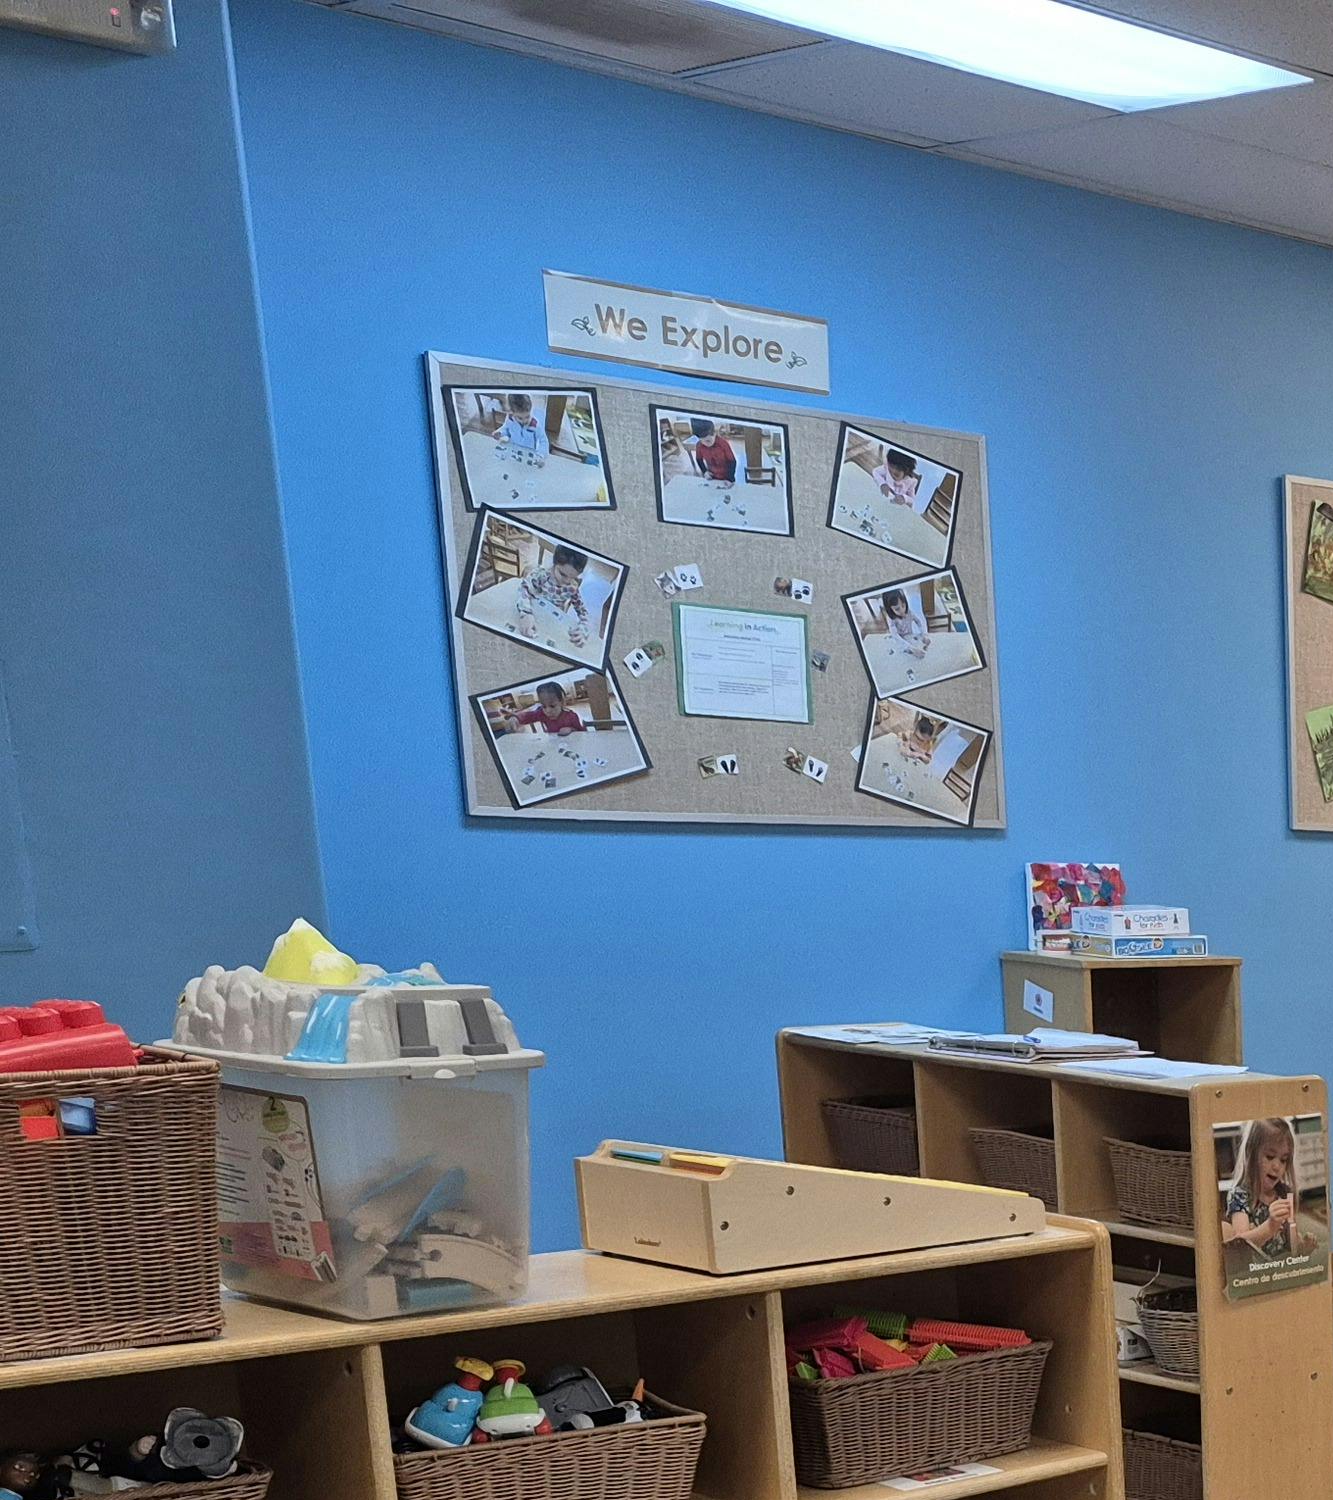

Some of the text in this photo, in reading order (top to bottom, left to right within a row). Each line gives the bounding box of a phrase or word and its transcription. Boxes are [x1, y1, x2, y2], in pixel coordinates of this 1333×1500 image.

[594, 303, 784, 365] We Explore
[1249, 1254, 1310, 1272] Discovery Center
[1233, 1277, 1260, 1287] Centro
[1260, 1274, 1271, 1283] de
